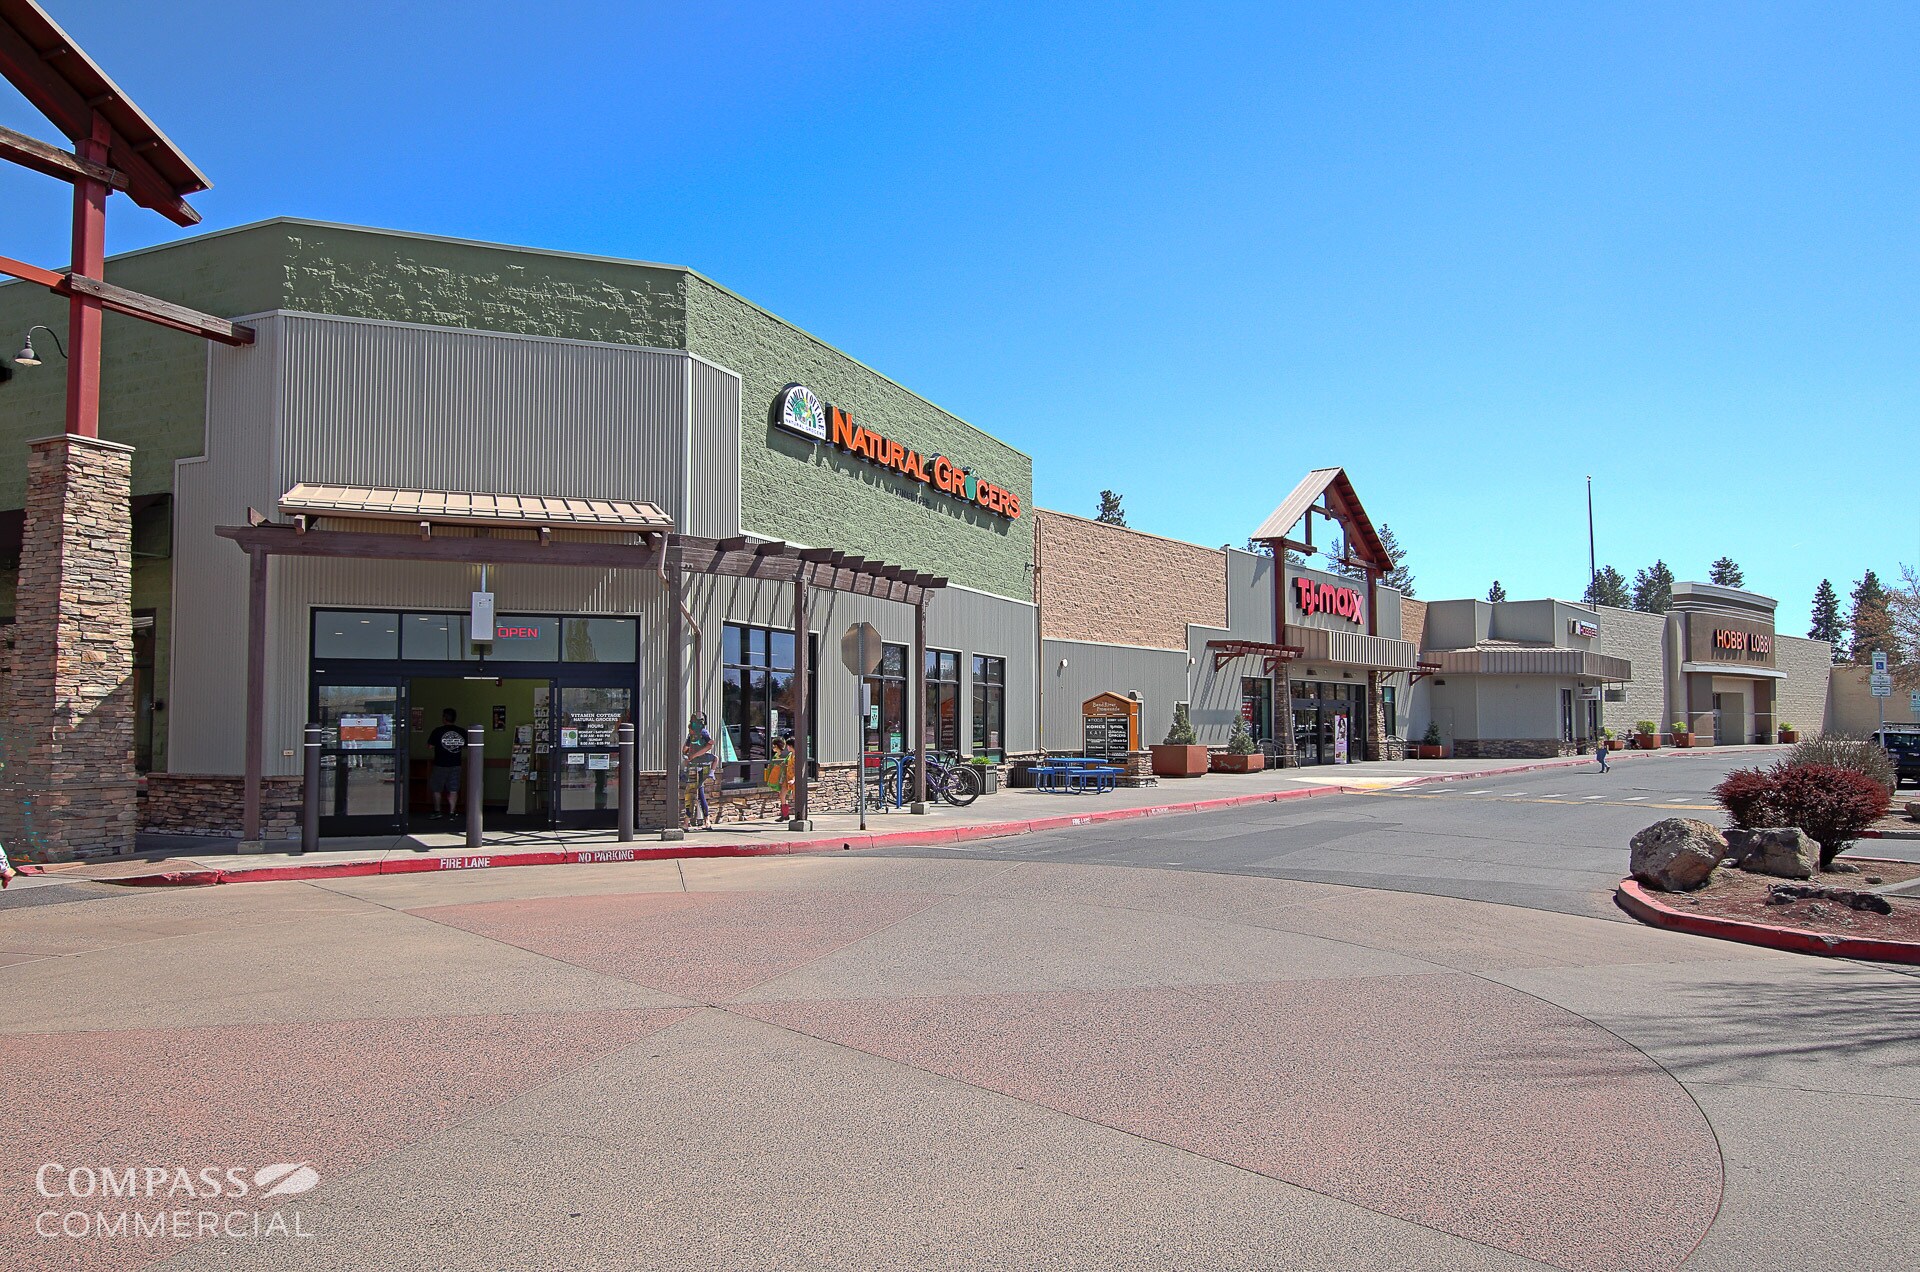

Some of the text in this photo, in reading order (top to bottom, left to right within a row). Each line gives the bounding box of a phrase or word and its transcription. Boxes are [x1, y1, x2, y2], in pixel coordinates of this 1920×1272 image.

[832, 405, 1022, 519] NATURAL GROCERS
[497, 627, 539, 638] OPEN
[1716, 629, 1772, 654] HOBBY LOBBY
[440, 857, 491, 869] FIRE LANE
[577, 850, 635, 863] NO PARKING
